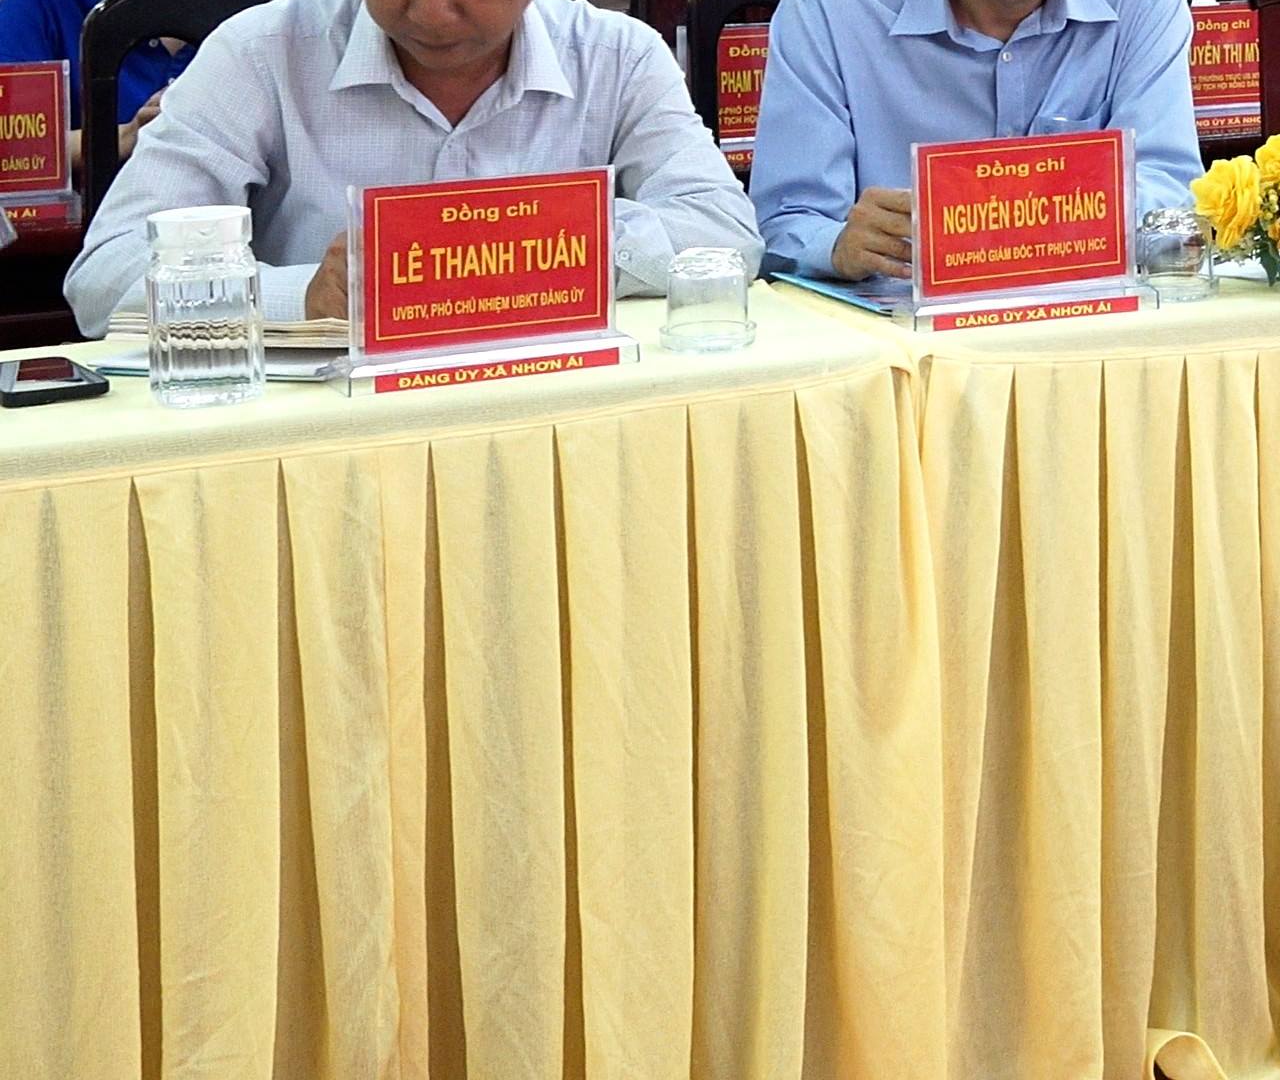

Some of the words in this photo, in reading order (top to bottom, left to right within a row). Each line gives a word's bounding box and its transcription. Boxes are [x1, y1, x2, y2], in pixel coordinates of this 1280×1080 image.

[1196, 19, 1229, 32] Đồng
[1232, 19, 1250, 30] chí
[1223, 43, 1243, 68] THỊ
[721, 70, 751, 98] PHẠM
[2, 156, 30, 171] ĐẢNG
[32, 154, 46, 169] ỦY
[976, 160, 1029, 178] Đồng
[1036, 156, 1065, 172] chí
[441, 203, 500, 223] Đồng
[506, 199, 539, 218] chí
[943, 195, 1010, 235] NGUYỄN
[1013, 191, 1049, 227] ĐỨC
[1052, 186, 1107, 224] THẮNG
[392, 242, 424, 284] LÊ
[430, 240, 514, 280] THANH
[522, 229, 587, 272] TUẤN
[988, 246, 1011, 263] GIÁM
[1012, 243, 1033, 260] ĐỐC
[1035, 244, 1046, 257] TT
[1047, 241, 1072, 259] PHỤC
[1073, 240, 1087, 256] VỤ
[1088, 237, 1107, 252] HCC
[393, 304, 429, 321] UVBTV,
[431, 299, 453, 318] PHÓ
[455, 296, 477, 315] CHỦ
[478, 293, 510, 314] NHIỆM
[512, 292, 539, 310] UBKT
[541, 287, 569, 306] ĐẢNG
[570, 286, 585, 303] ỦY
[955, 313, 999, 328] ĐẢNG
[1003, 308, 1024, 324] ỦY
[1027, 306, 1047, 320] XÃ
[1051, 303, 1094, 318] NHƠN
[1097, 302, 1111, 313] ÁI
[398, 370, 450, 389] ĐẢNG
[455, 366, 479, 382] ỦY
[483, 363, 507, 378] XÃ
[511, 358, 562, 375] NHƠN
[566, 355, 583, 368] ÁI
